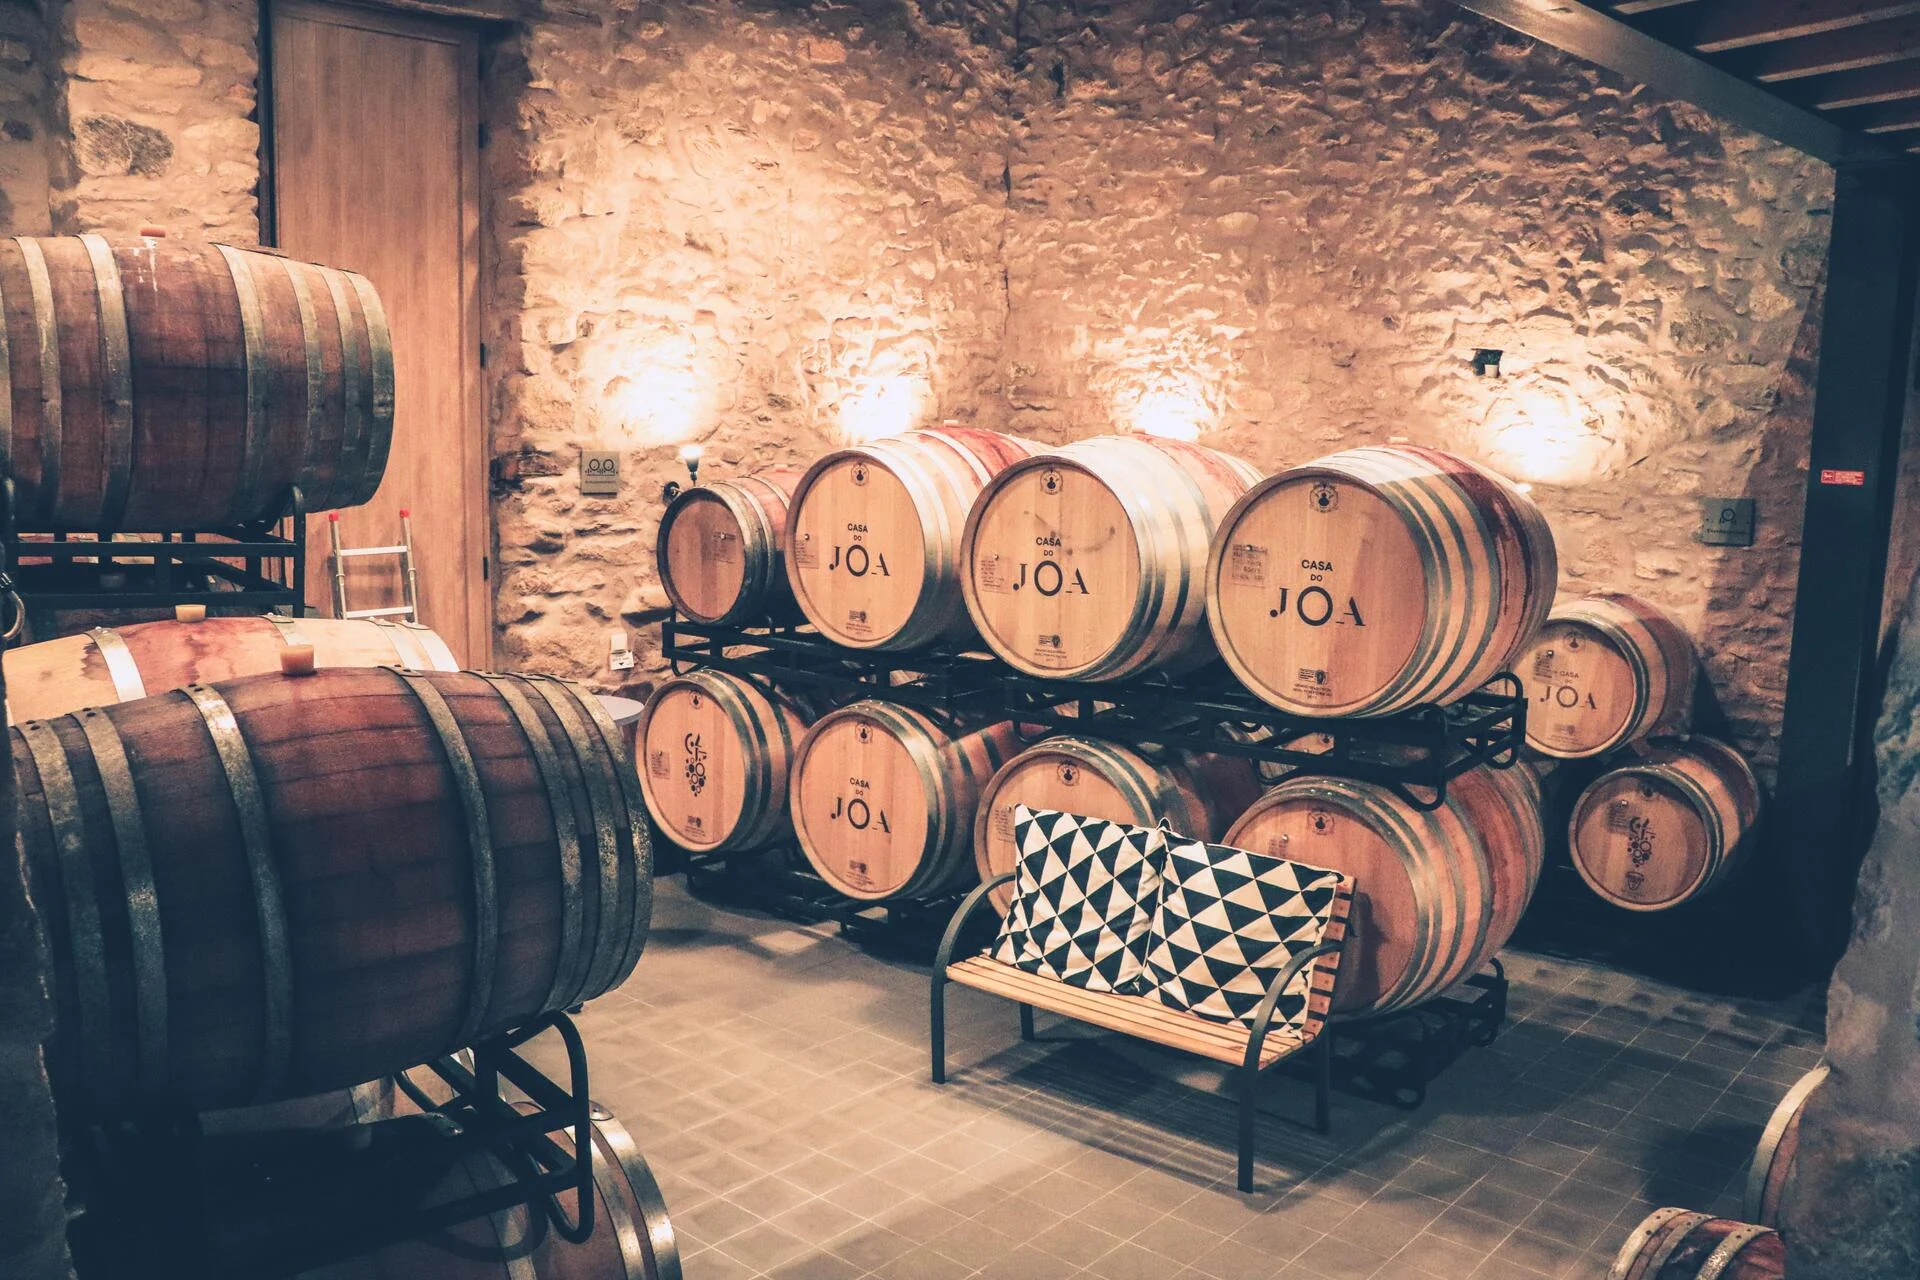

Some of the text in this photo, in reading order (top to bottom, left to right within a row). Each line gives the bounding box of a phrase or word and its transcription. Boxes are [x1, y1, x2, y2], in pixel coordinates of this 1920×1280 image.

[847, 523, 868, 534] CASA
[1036, 537, 1062, 547] CASA
[829, 544, 890, 577] JOA
[1301, 559, 1333, 572] CASA
[1012, 560, 1090, 597] JOA
[1310, 573, 1323, 582] DO
[1269, 585, 1366, 627] JOA
[1559, 670, 1579, 679] CASA
[1540, 685, 1597, 710] JOA
[849, 777, 870, 789] CASA
[830, 797, 891, 834] JOA
